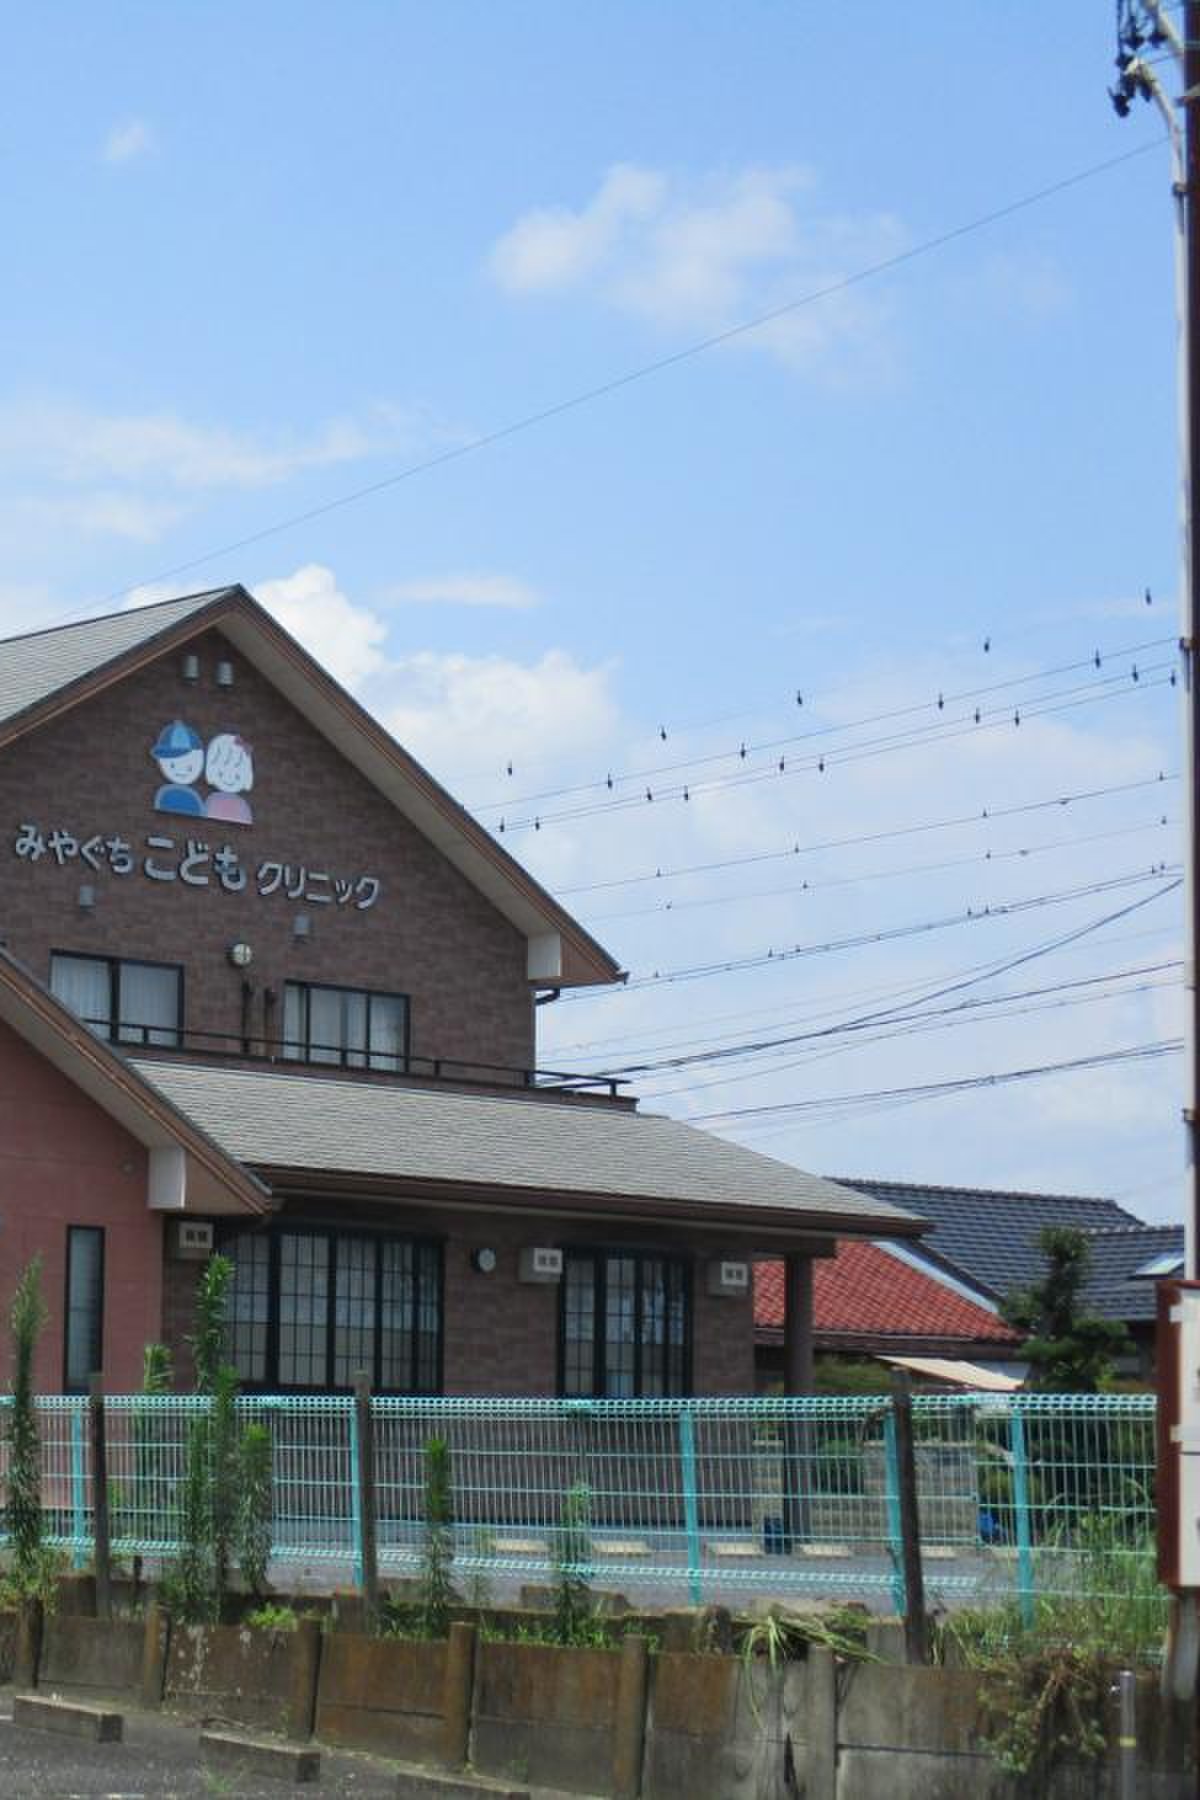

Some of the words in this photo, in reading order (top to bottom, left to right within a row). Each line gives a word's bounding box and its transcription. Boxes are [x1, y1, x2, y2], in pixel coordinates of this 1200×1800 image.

[15, 824, 134, 874] みやぐち
[144, 835, 248, 891] こども
[257, 862, 380, 910] クリニック
